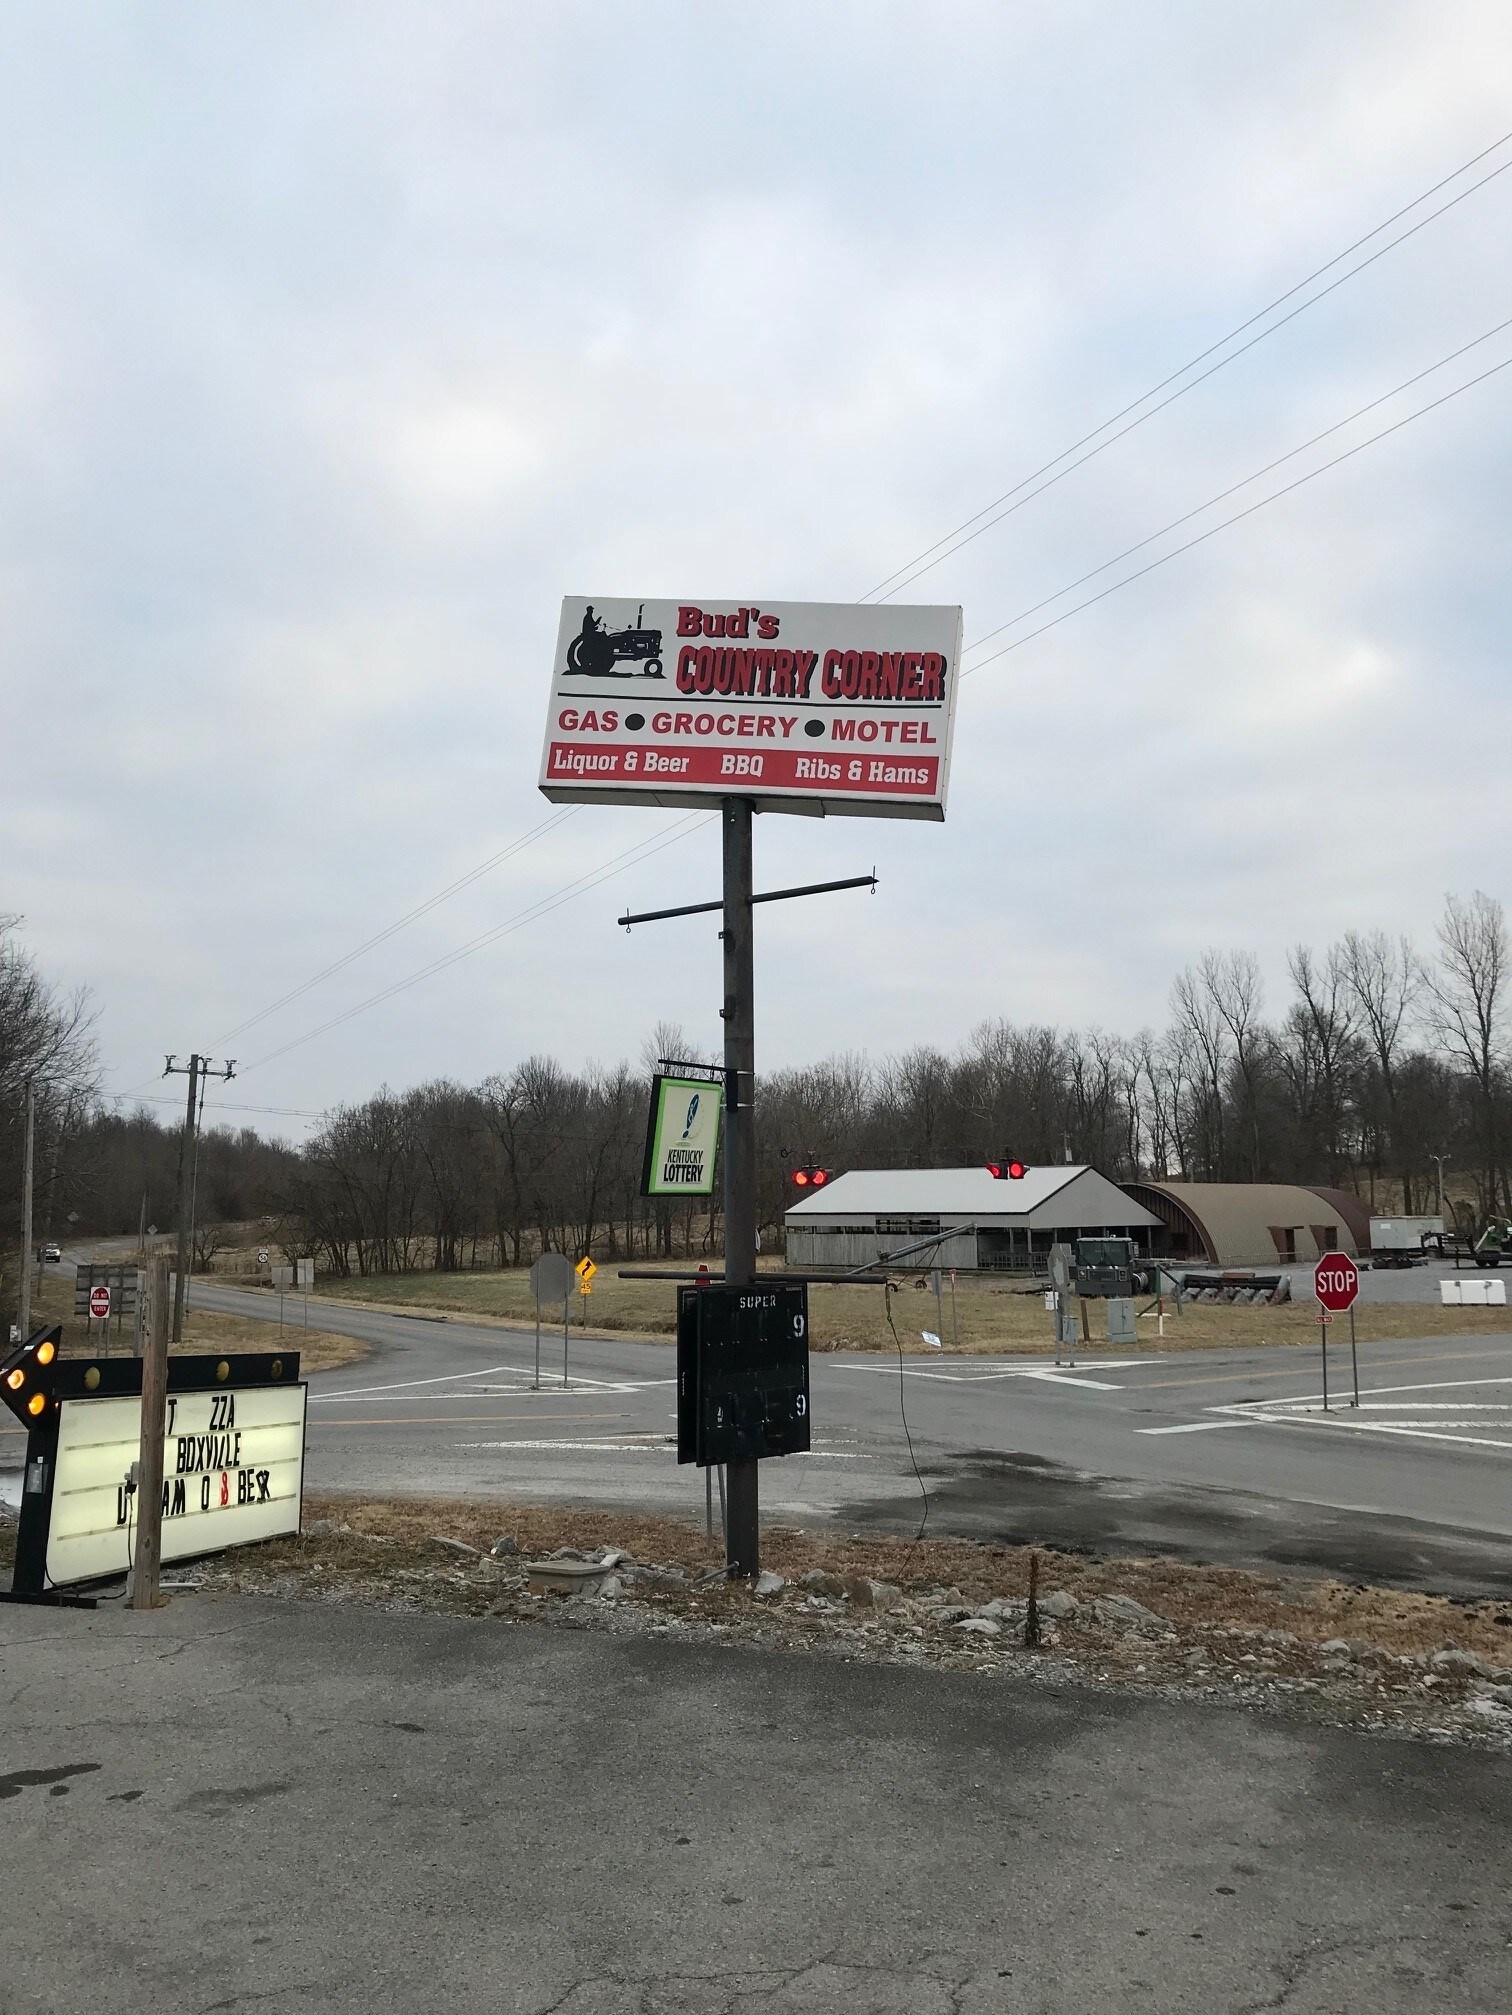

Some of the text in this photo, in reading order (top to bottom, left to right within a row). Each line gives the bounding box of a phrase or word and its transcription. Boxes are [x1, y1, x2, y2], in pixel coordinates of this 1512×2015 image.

[676, 606, 780, 639] Bud's
[676, 645, 947, 701] COUNTRY CORNER
[558, 709, 937, 744] GAS GROCERY MOTEL
[553, 749, 930, 785] Liquor & Beer BBQ Ribs & Hams
[667, 1149, 703, 1163] KENTUCKY
[663, 1163, 704, 1182] LOTTERY
[1317, 1270, 1356, 1293] STOP
[740, 1295, 776, 1308] SUPER
[793, 1315, 805, 1337] 9
[209, 1394, 235, 1430] ZZA
[796, 1394, 806, 1416] 9
[176, 1432, 241, 1474] BOXVILLE
